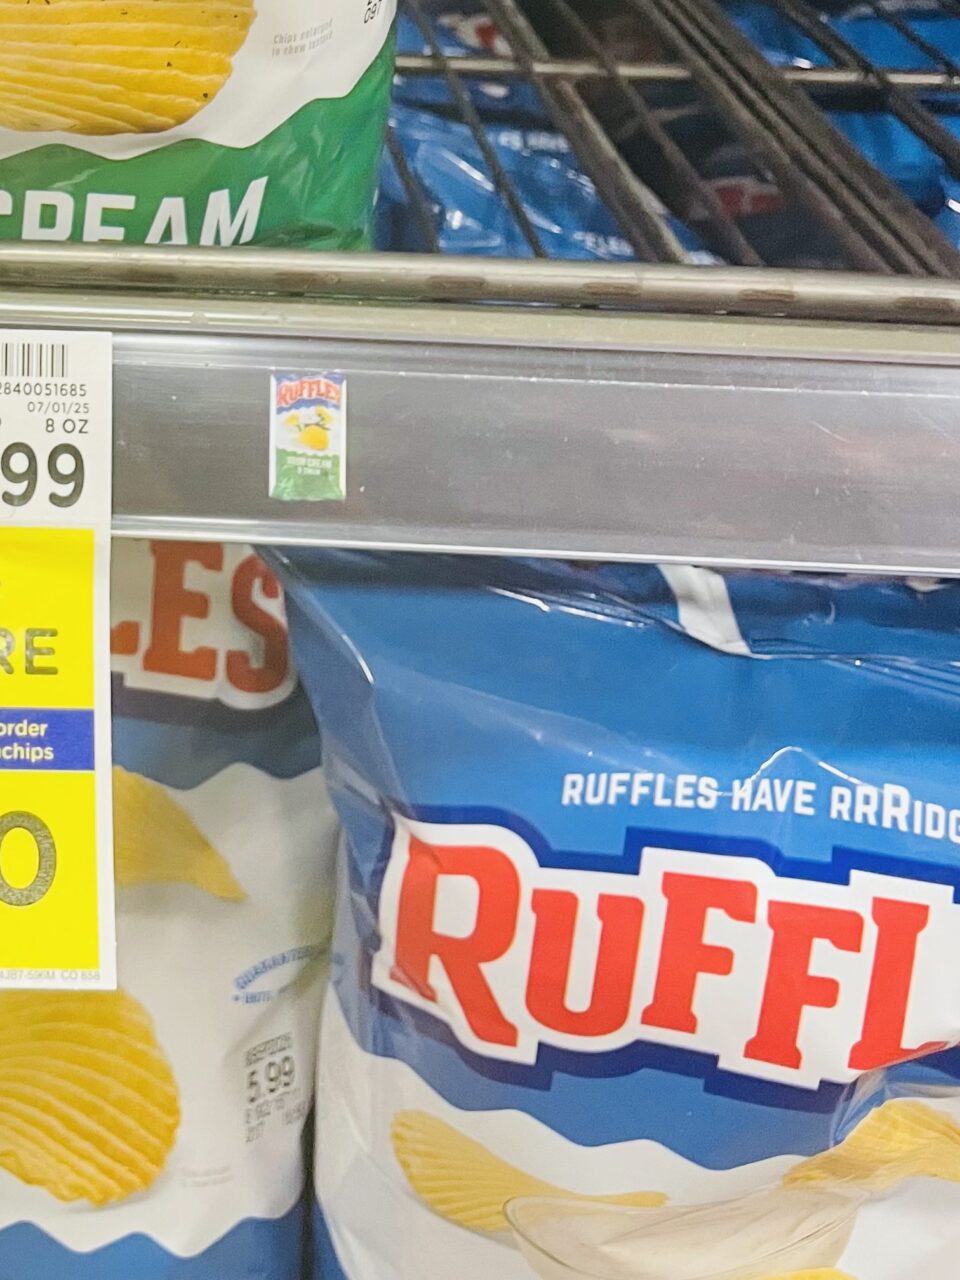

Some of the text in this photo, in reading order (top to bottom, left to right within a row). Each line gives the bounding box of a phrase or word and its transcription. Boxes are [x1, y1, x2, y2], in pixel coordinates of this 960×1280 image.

[27, 401, 90, 414] 07/01/25
[45, 419, 55, 434] 8
[62, 419, 89, 435] OZ
[561, 773, 719, 809] RUFFLES
[731, 778, 816, 816] HAVE
